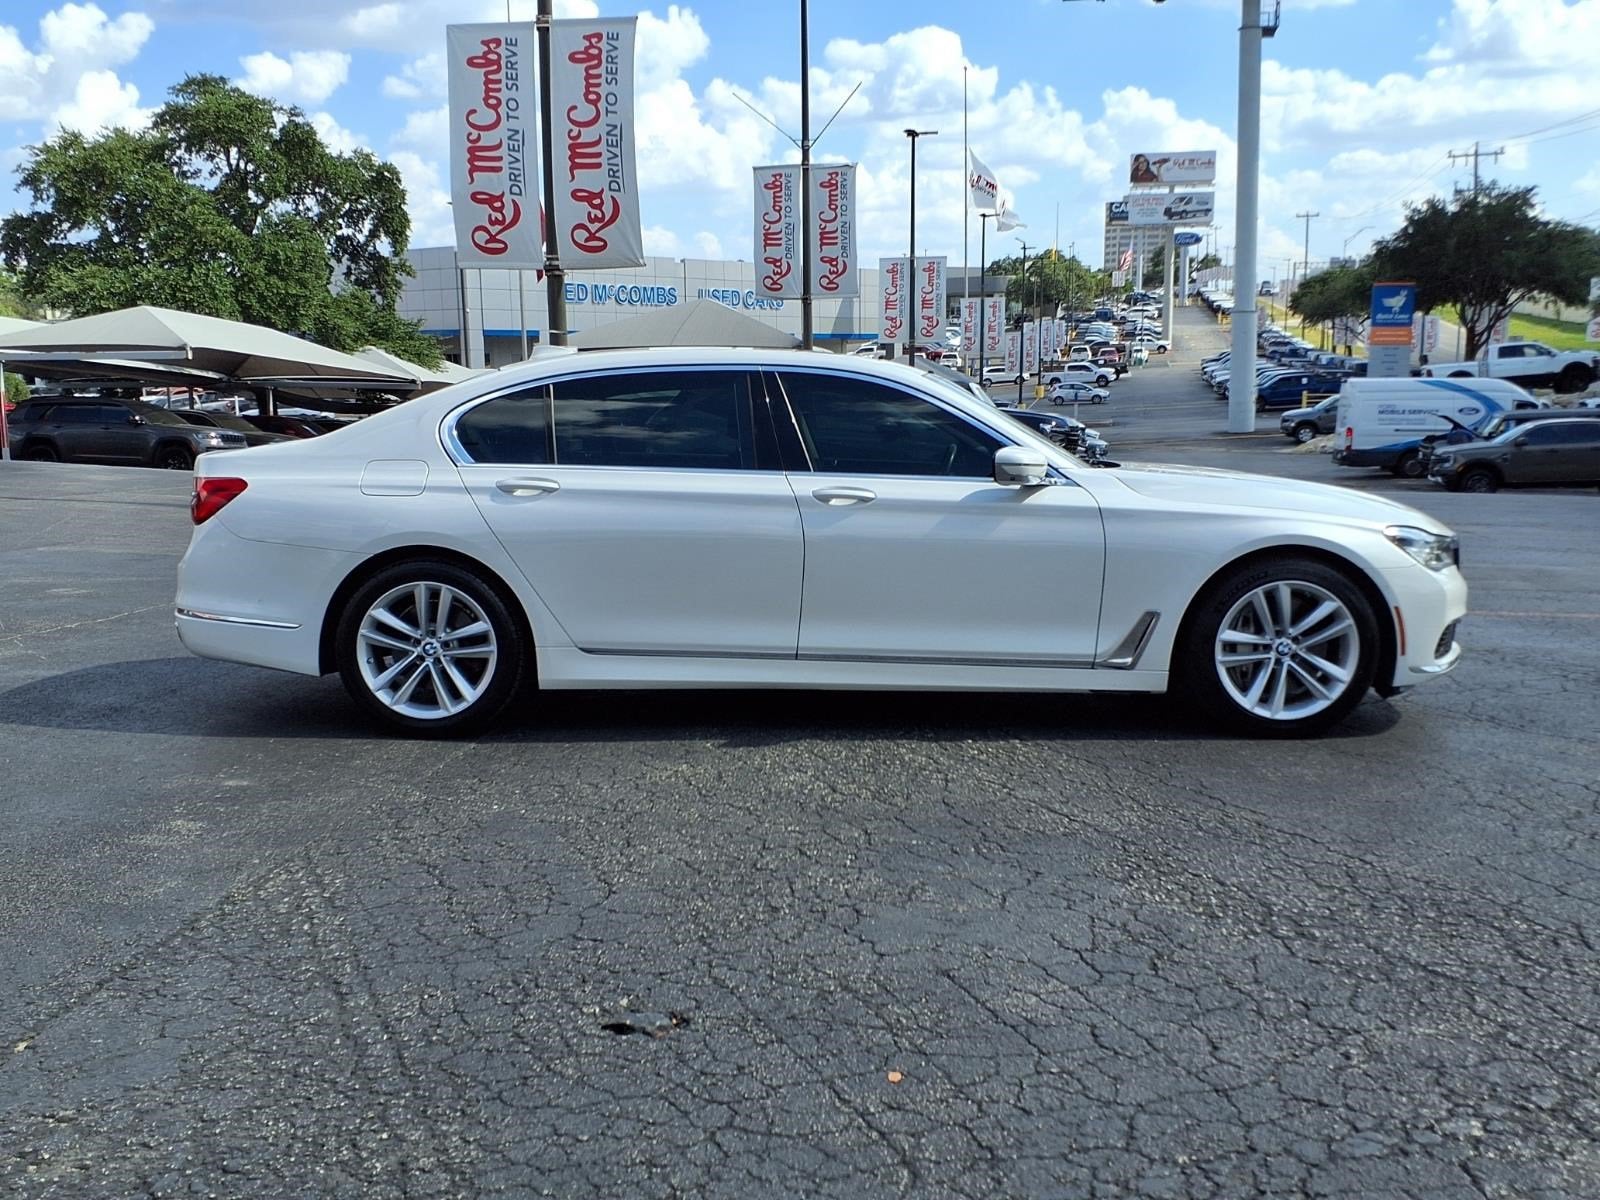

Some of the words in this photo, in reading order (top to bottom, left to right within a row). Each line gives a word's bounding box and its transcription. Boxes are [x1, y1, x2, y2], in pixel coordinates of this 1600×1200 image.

[505, 37, 518, 91] SERVE
[606, 32, 619, 86] SERVE
[466, 38, 503, 184] McCombs
[506, 98, 519, 122] TO
[566, 32, 604, 183] McCombs
[606, 93, 618, 119] TO
[508, 128, 523, 197] DRIVEN
[606, 124, 620, 193] DRIVEN
[784, 173, 792, 202] SERVE
[840, 171, 848, 200] SERVE
[471, 191, 521, 255] Red
[570, 188, 620, 254] Red
[763, 173, 783, 253] McCombs
[784, 205, 792, 218] TO
[819, 172, 839, 253] McCombs
[840, 205, 848, 217] TO
[784, 223, 793, 259] DRIVEN
[840, 221, 849, 258] DRIVEN
[763, 257, 791, 292] Red
[819, 256, 847, 291] Red
[885, 263, 898, 314] McCombs
[921, 261, 935, 312] McCombs
[565, 283, 588, 302] ED
[884, 316, 902, 338] Red
[920, 315, 939, 337] Red
